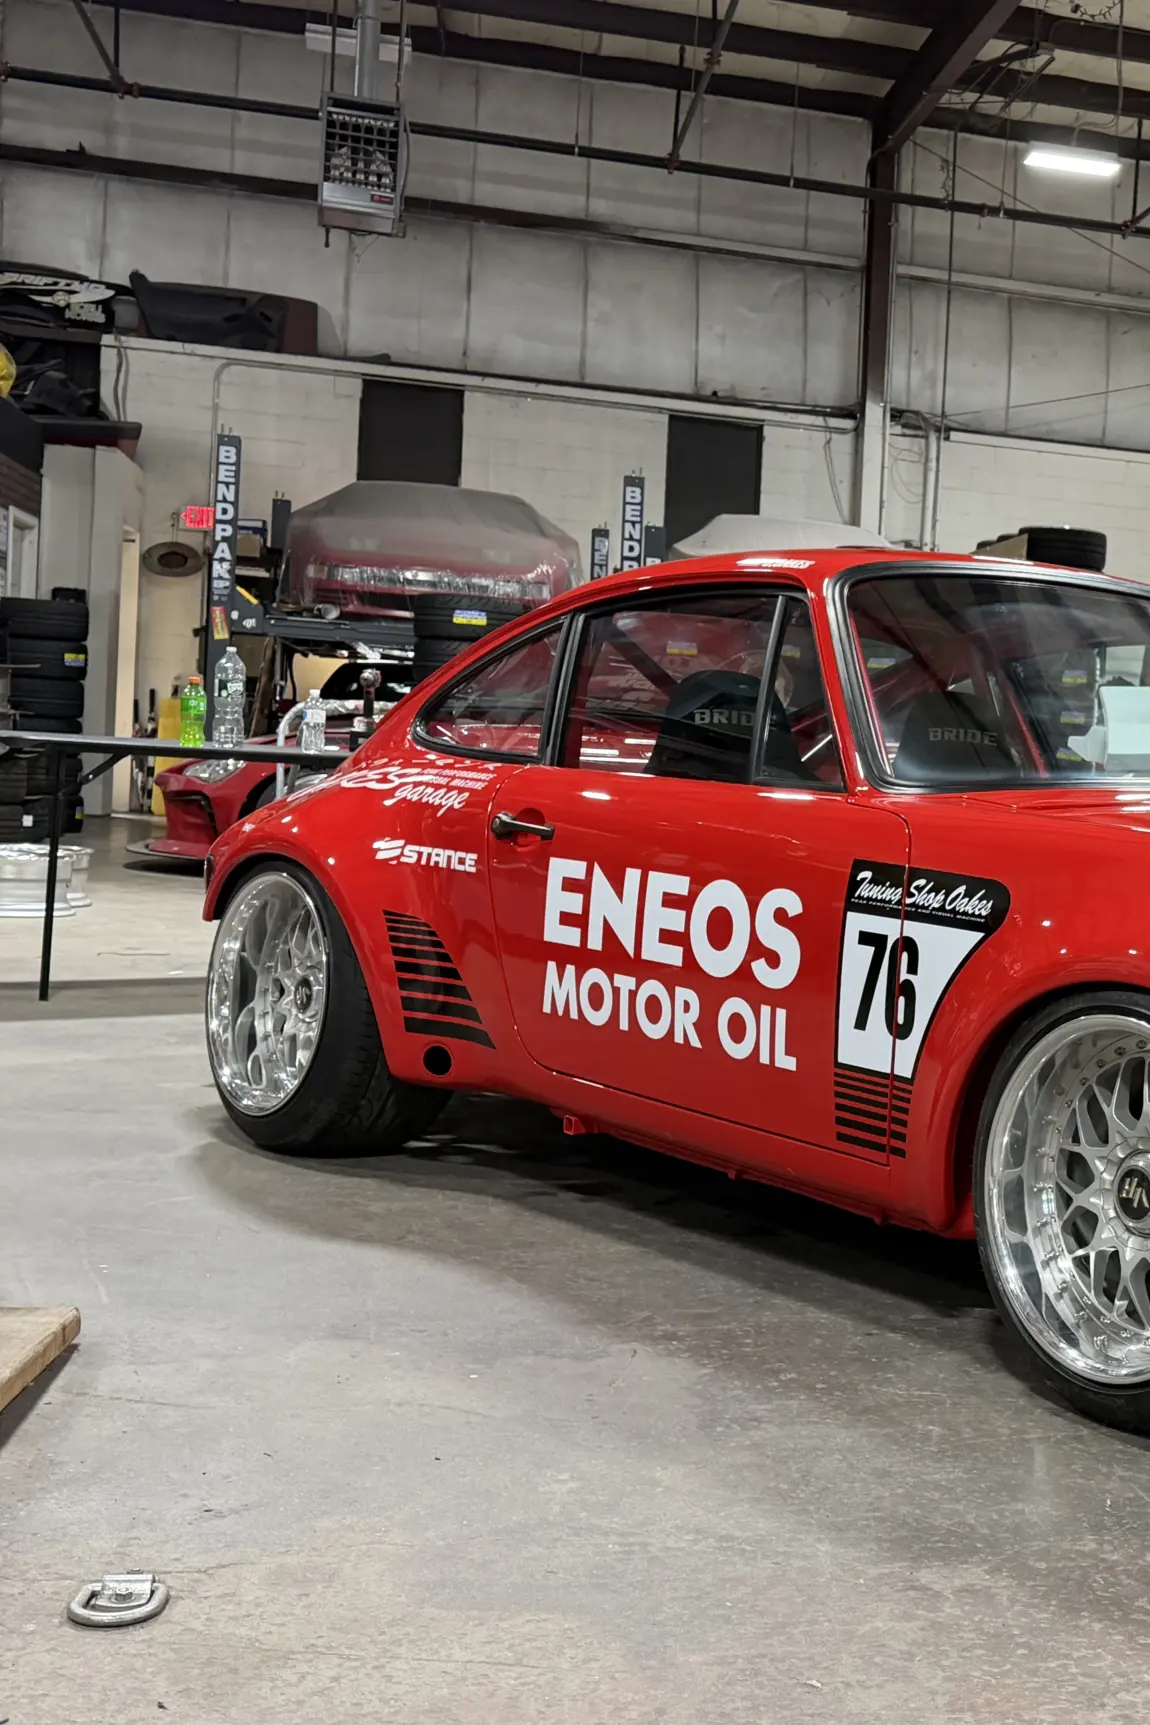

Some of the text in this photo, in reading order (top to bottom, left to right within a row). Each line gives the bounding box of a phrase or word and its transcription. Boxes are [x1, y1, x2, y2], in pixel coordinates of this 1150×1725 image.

[186, 505, 214, 528] EXIT
[212, 445, 237, 579] BENDPAK
[928, 727, 998, 746] BRIDE
[383, 783, 470, 817] garage
[400, 844, 478, 873] STANCE
[855, 870, 994, 917] Tuning Shop Oakes
[543, 856, 804, 990] ENEOS
[956, 914, 986, 923] MACHINE
[853, 930, 919, 1041] 76
[543, 960, 797, 1071] MOTOR OIL
